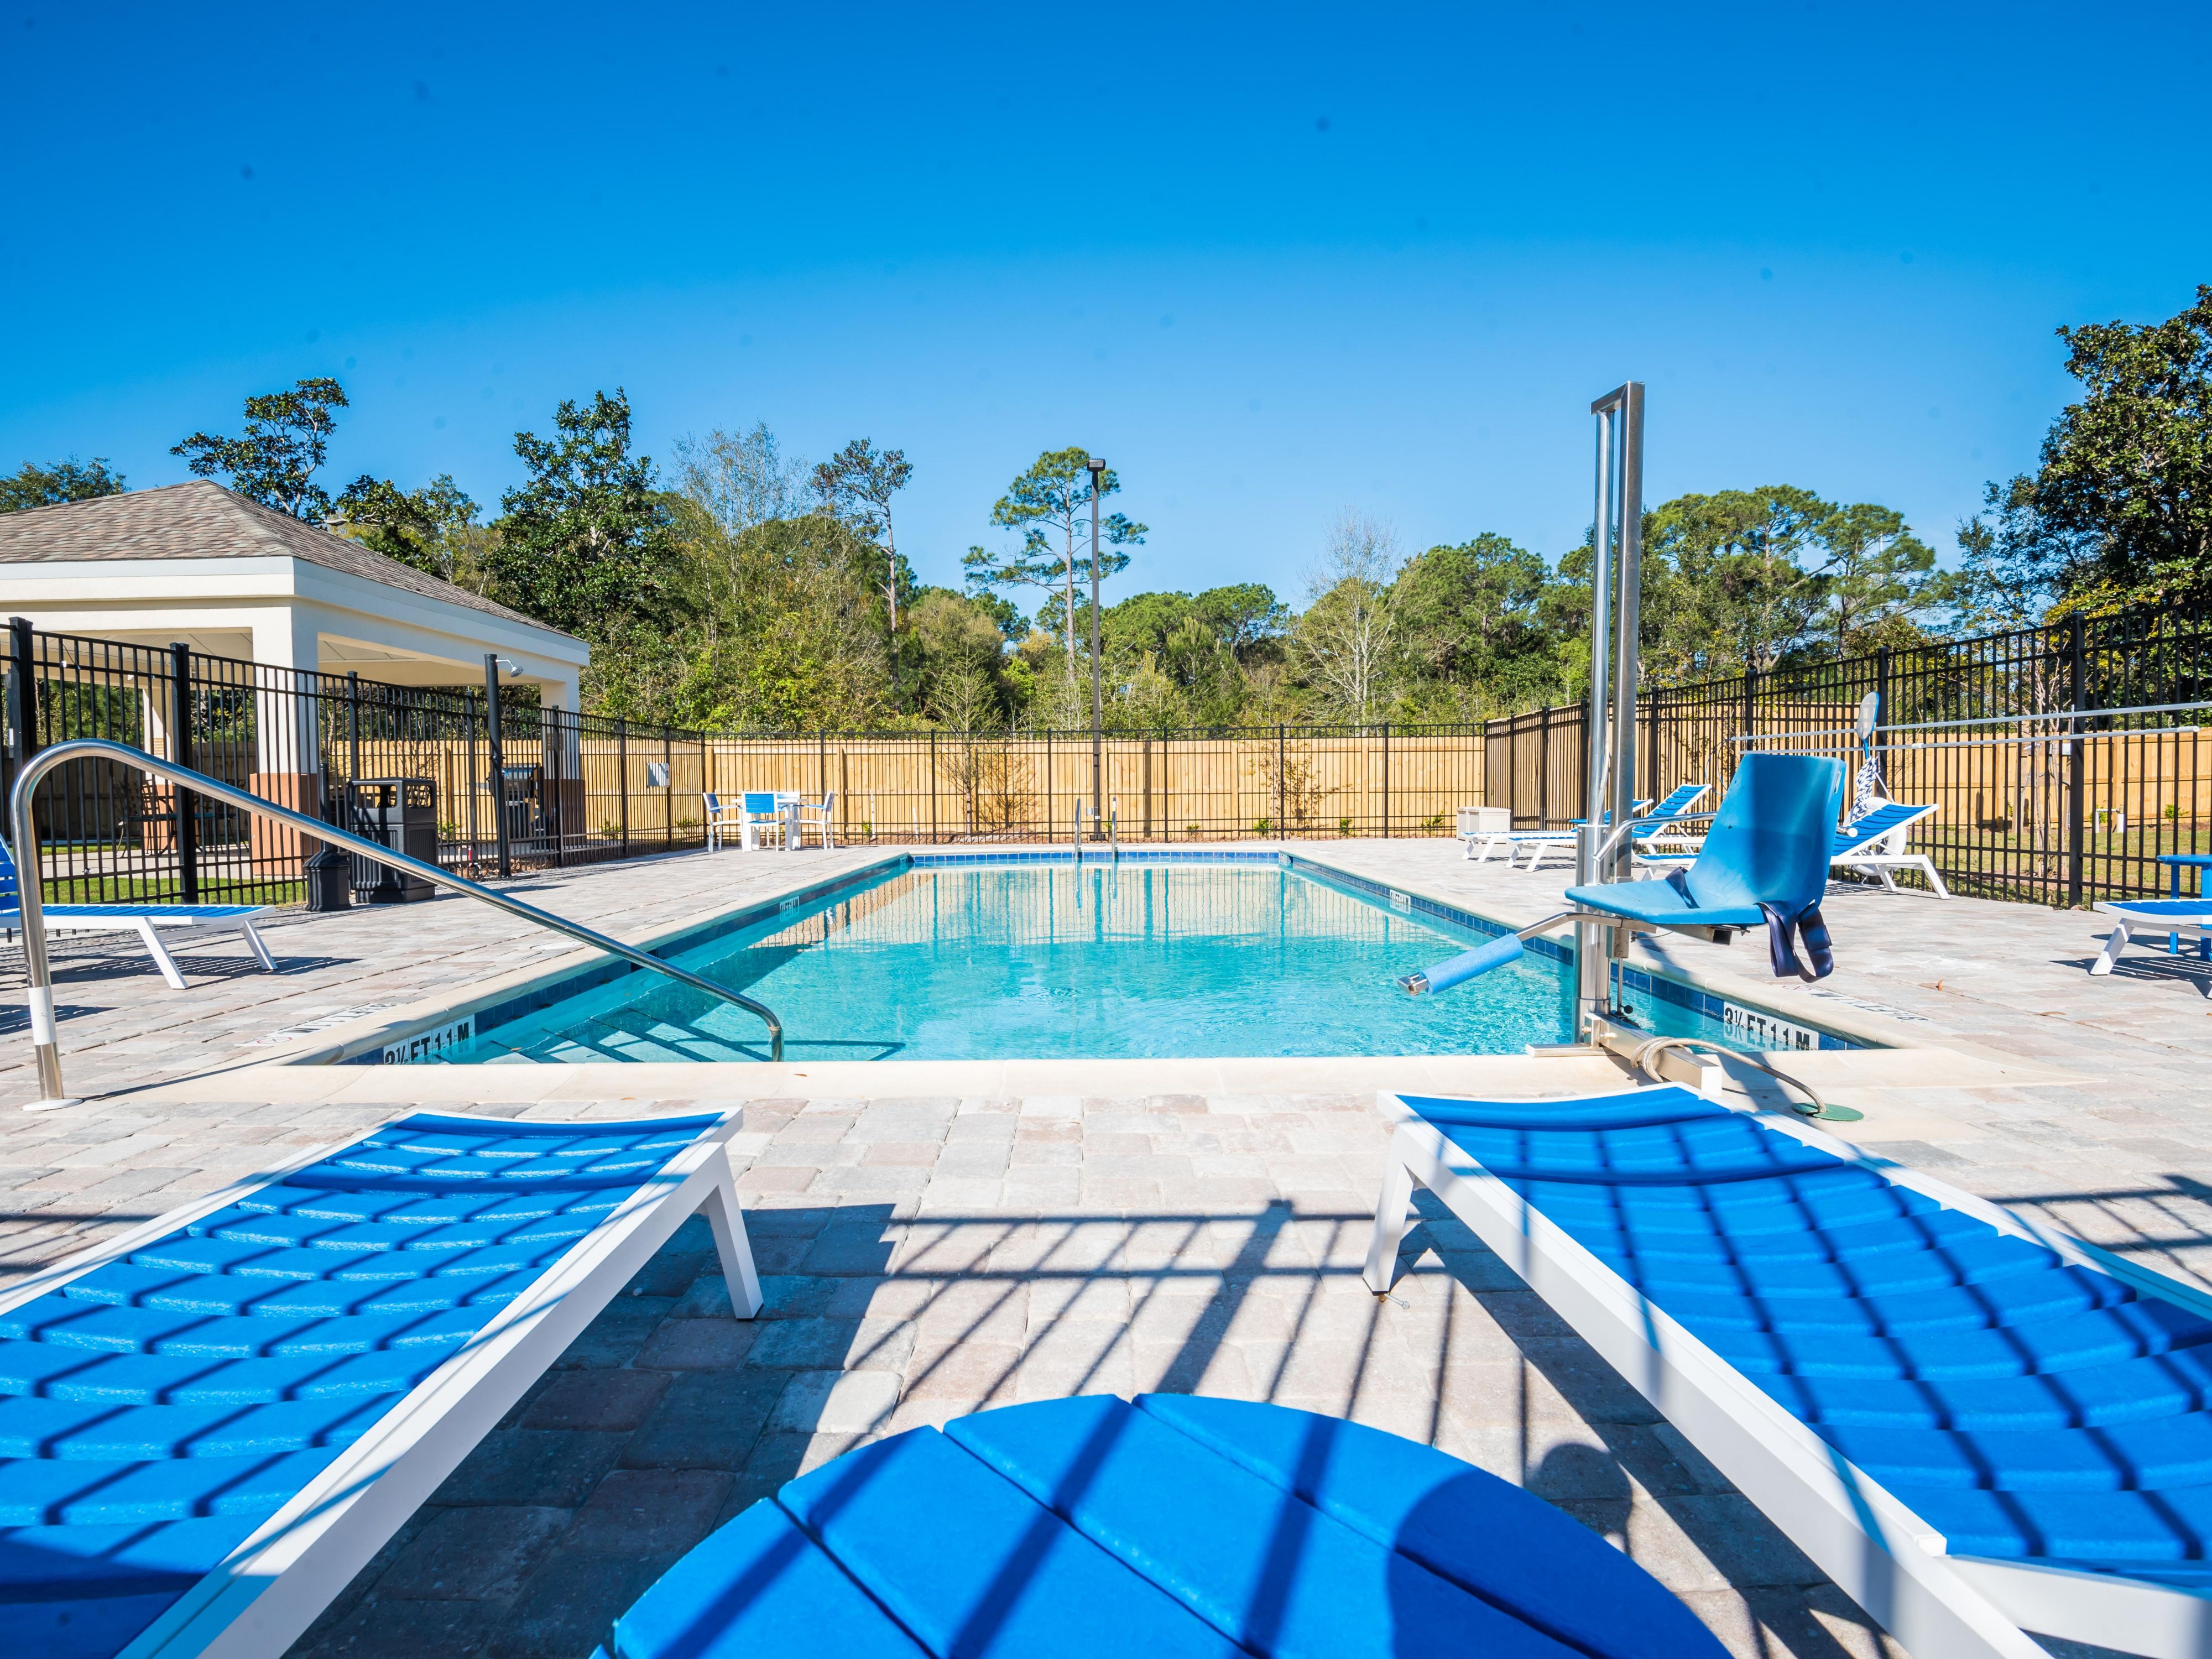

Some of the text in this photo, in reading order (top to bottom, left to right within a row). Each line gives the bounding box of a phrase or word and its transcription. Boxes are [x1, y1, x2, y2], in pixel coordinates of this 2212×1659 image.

[410, 1036, 430, 1062] FT
[458, 1022, 469, 1042] M
[1747, 1014, 1766, 1036] FT
[1796, 1031, 1809, 1051] M
